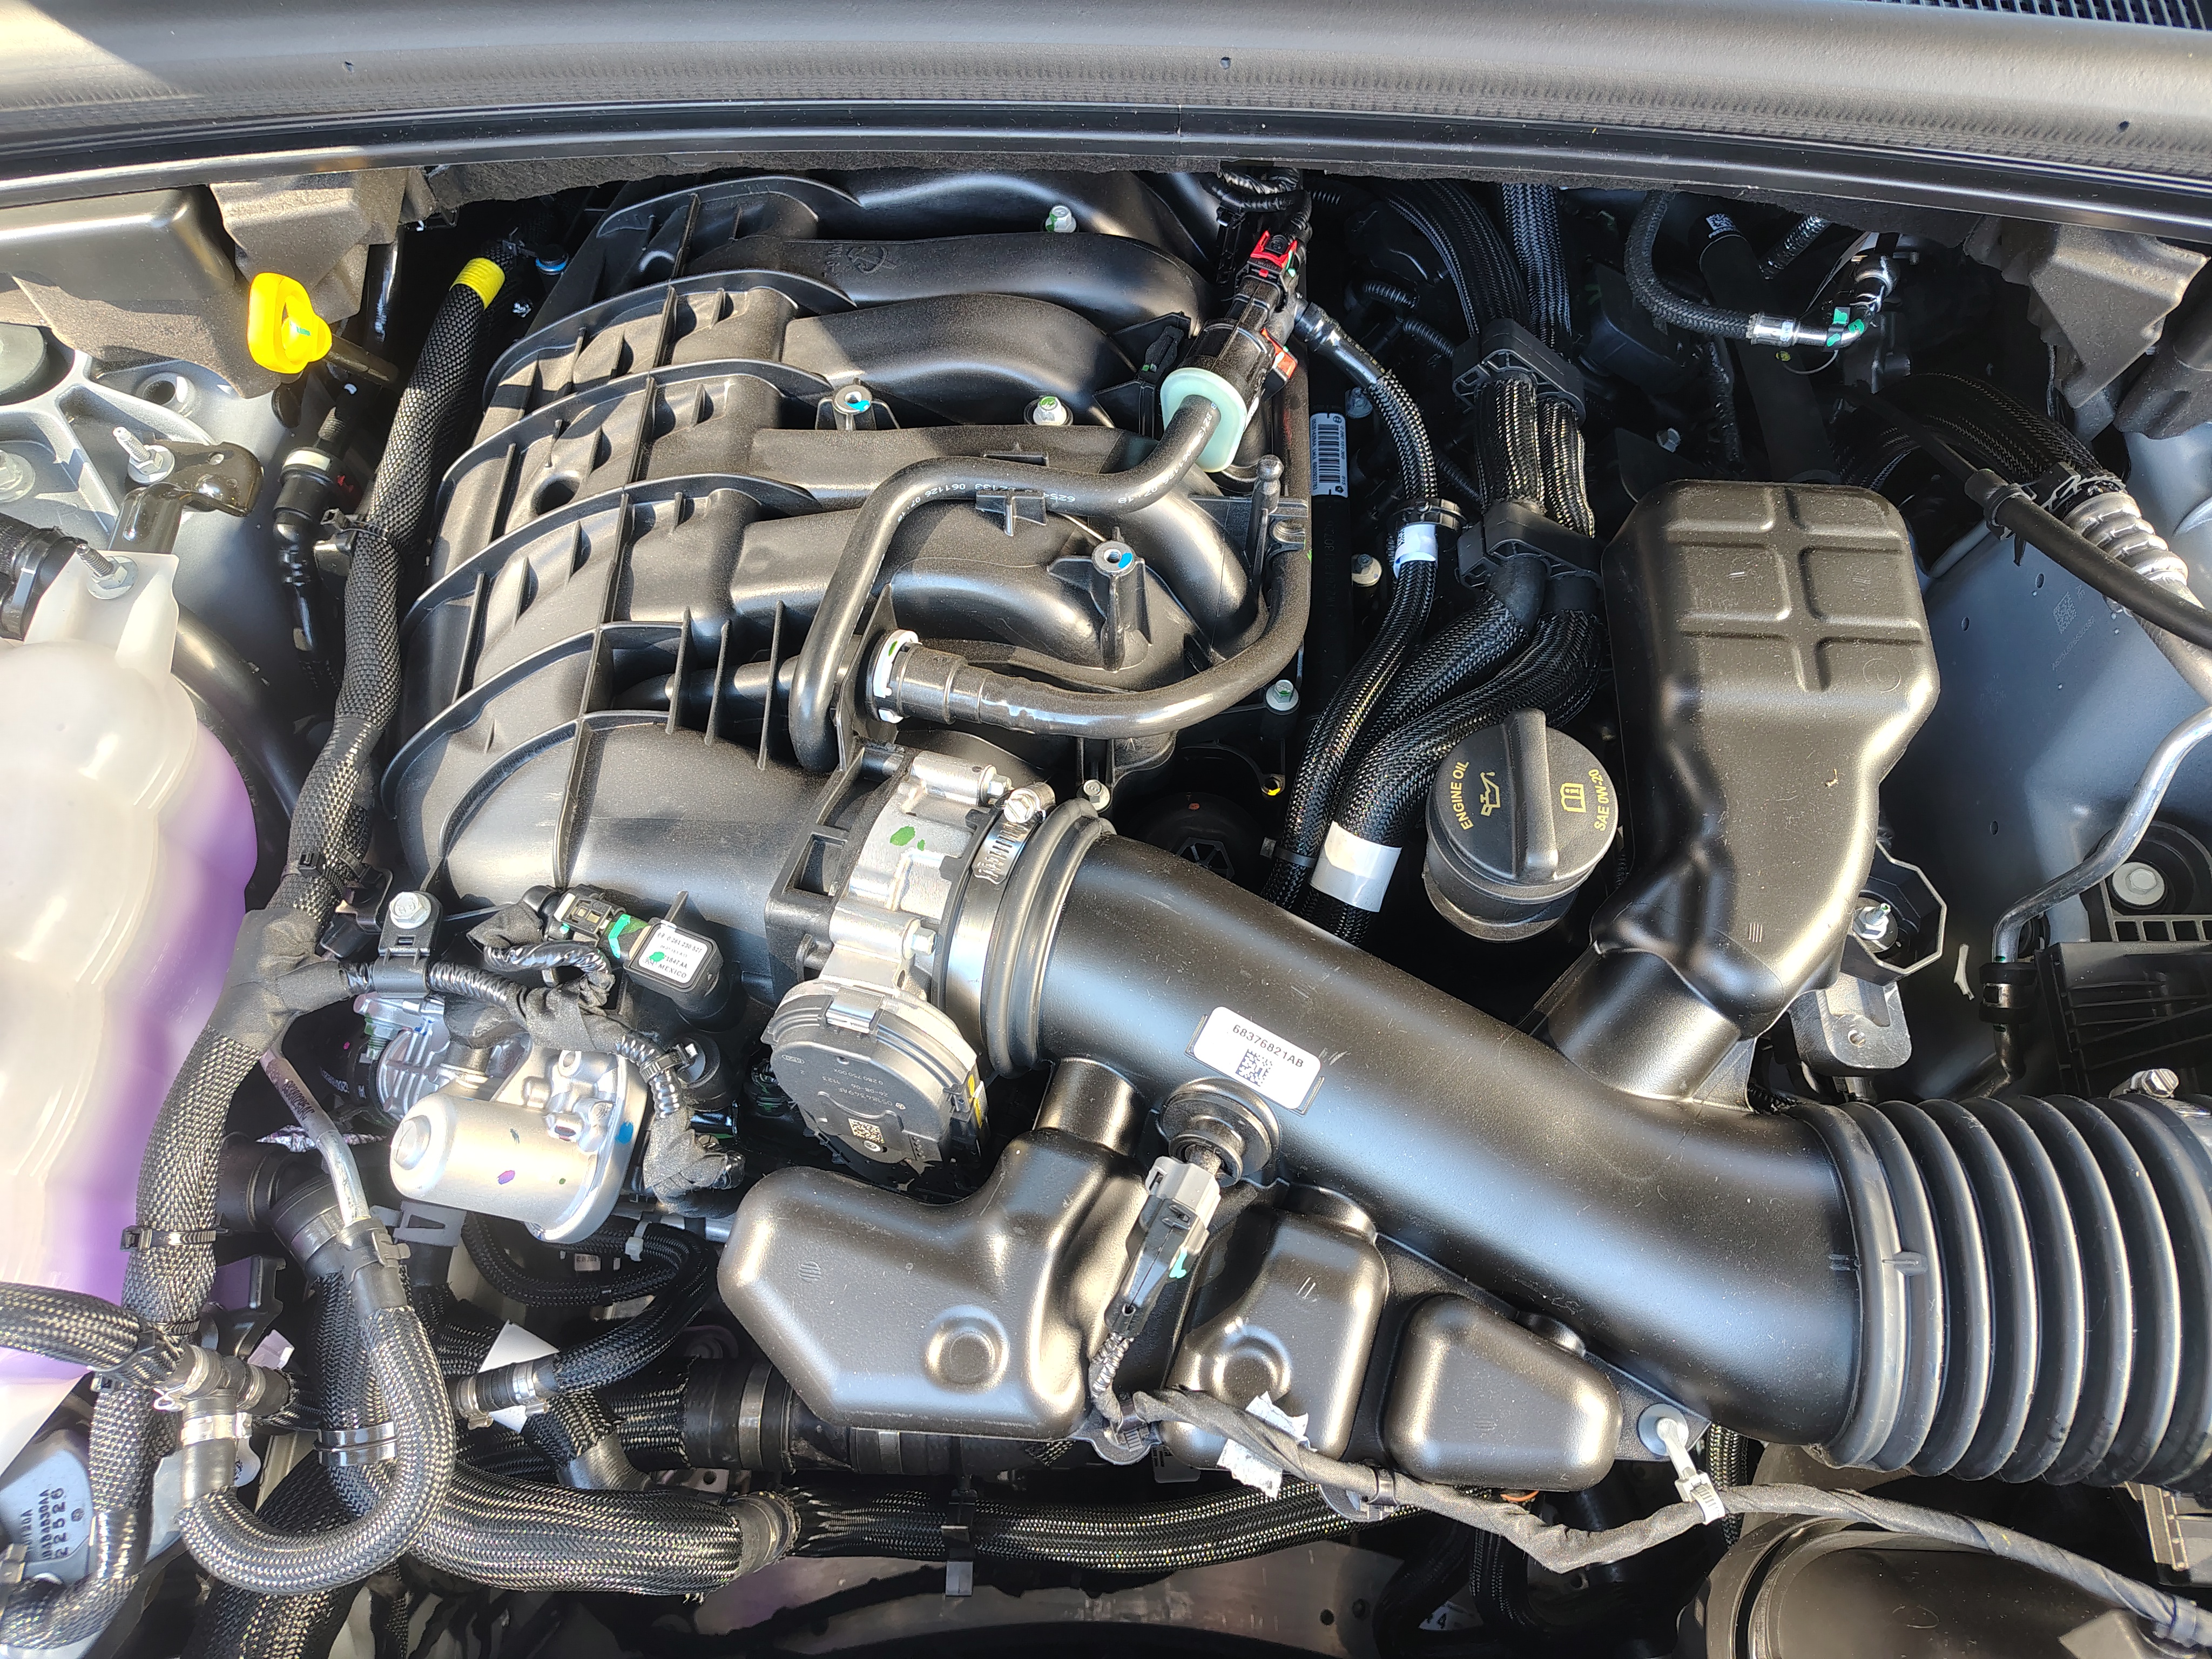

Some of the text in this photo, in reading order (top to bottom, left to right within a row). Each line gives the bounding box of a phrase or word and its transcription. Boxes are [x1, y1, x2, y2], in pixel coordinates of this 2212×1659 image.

[925, 483, 966, 497] 061126
[1450, 761, 1474, 830] ENGINE OIL
[1588, 768, 1610, 831] SAE 0W-20
[658, 963, 687, 978] MEXICO
[1232, 1024, 1304, 1068] 68376821AB
